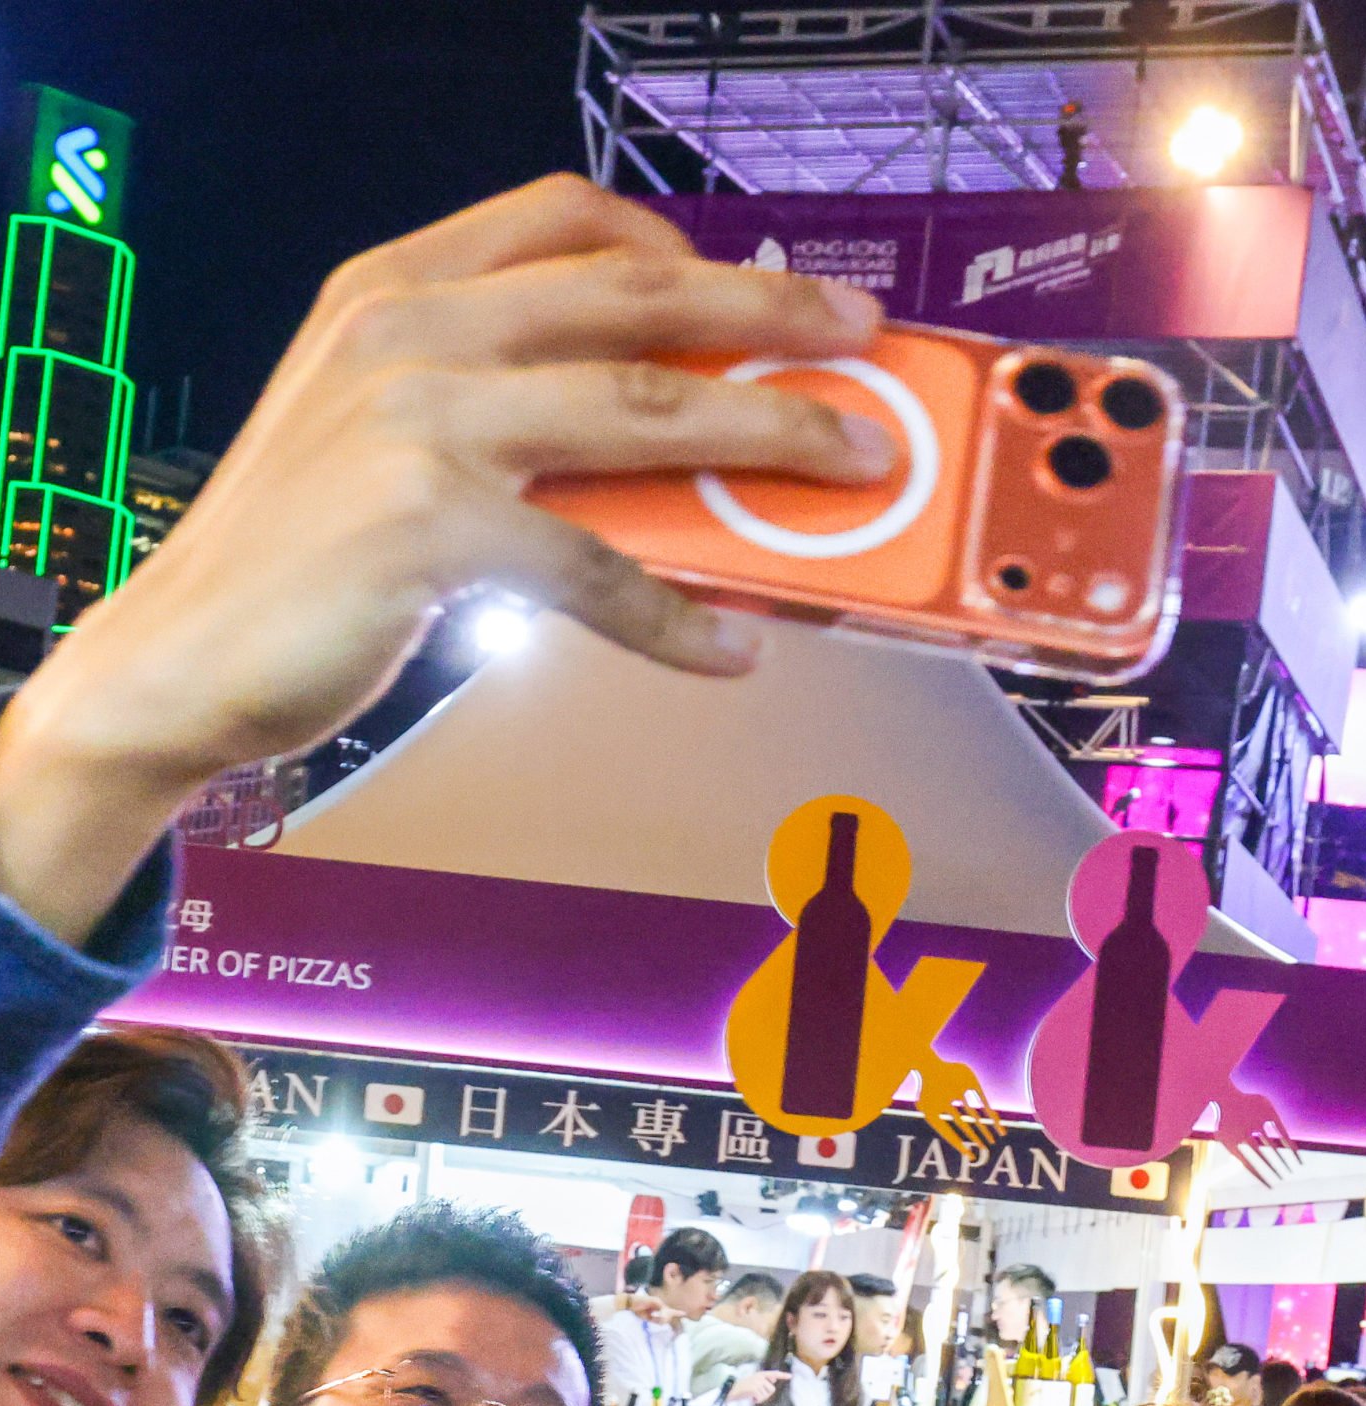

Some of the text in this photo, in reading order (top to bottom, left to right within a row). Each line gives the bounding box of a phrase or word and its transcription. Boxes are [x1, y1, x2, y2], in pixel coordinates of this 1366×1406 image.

[217, 950, 262, 979] OF
[267, 955, 373, 990] PIZZAS
[459, 1083, 773, 1164] 日本專區
[890, 1134, 1070, 1193] JAPAN
